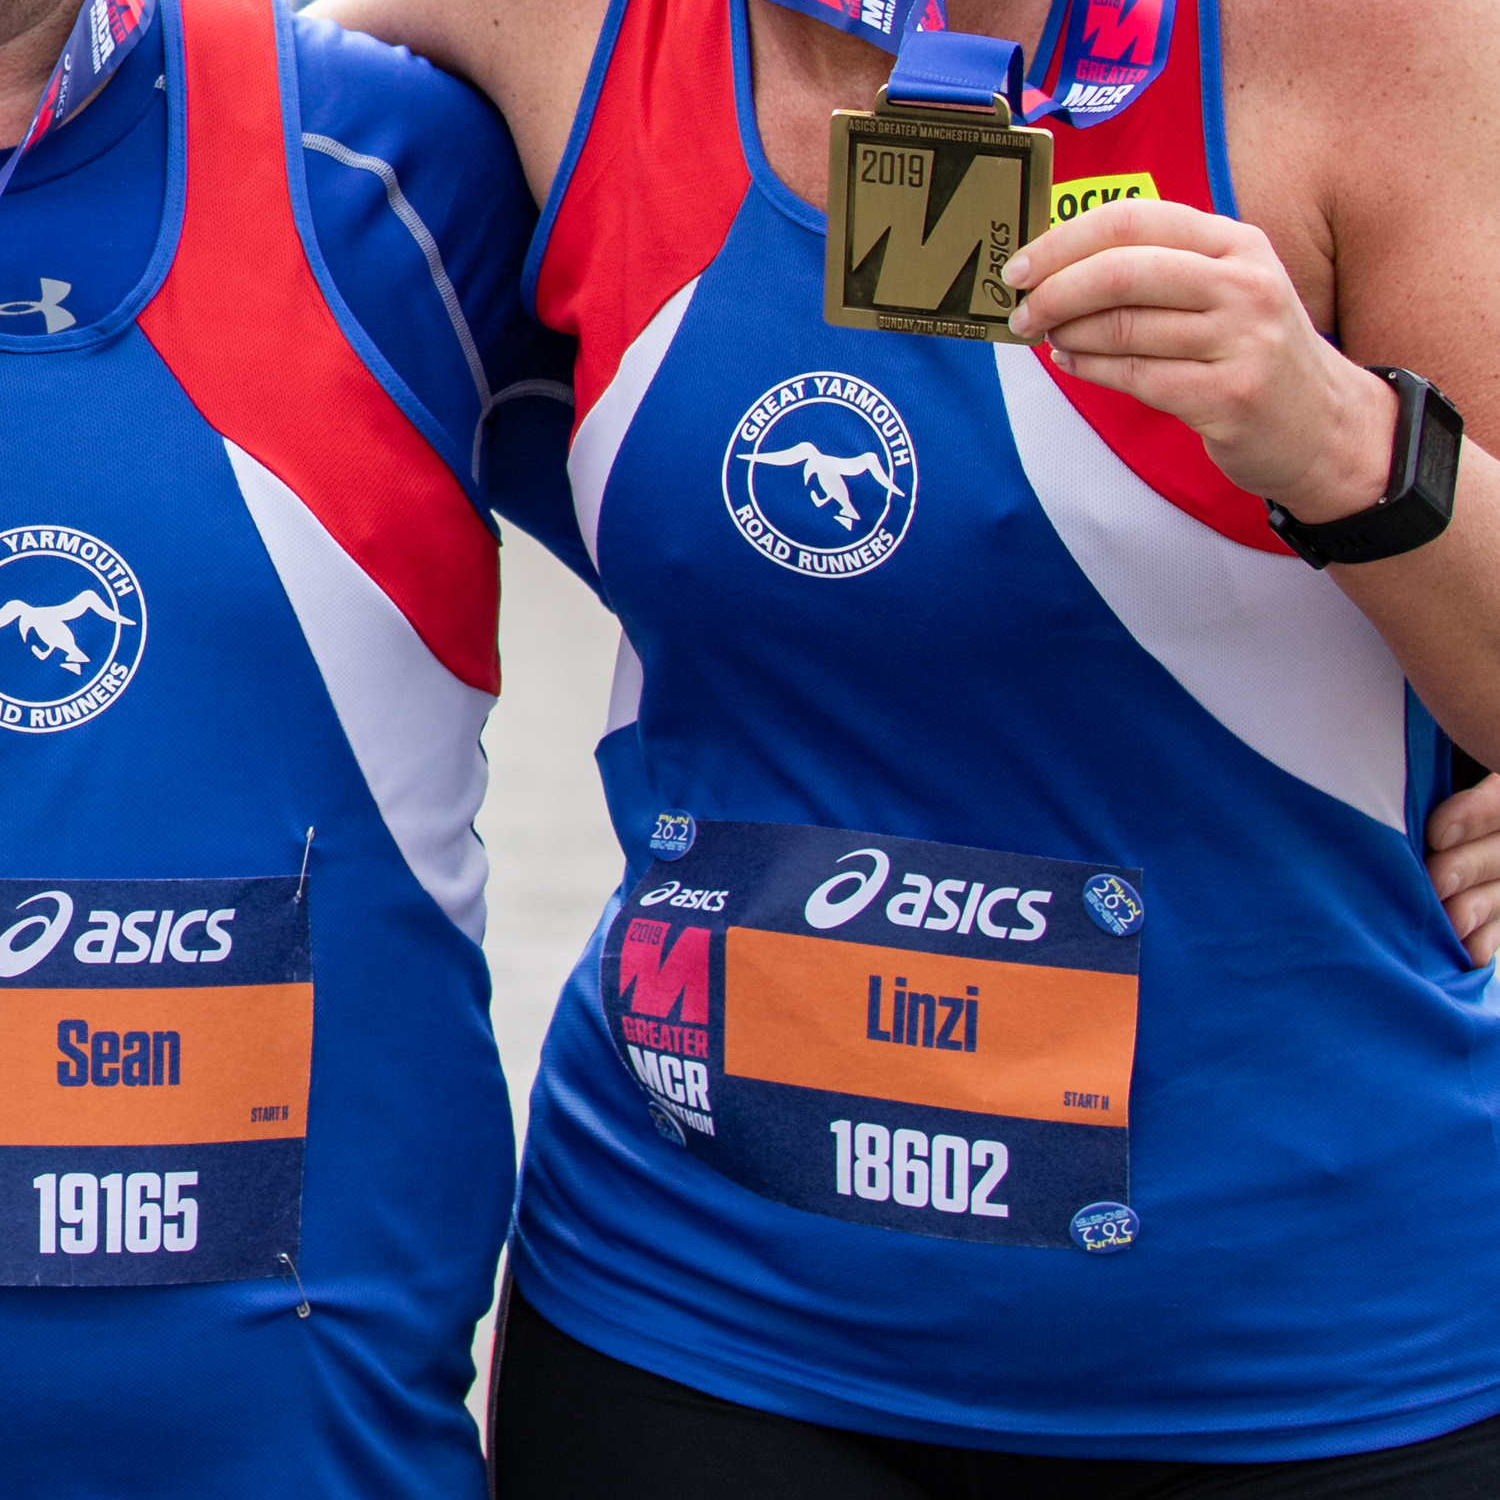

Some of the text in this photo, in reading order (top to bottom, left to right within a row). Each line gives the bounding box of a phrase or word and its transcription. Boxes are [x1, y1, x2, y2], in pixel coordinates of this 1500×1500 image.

[1075, 58, 1149, 84] GREATER
[1061, 82, 1135, 108] MCR
[849, 119, 1032, 148] ASICS GREATER MANCHESTER MARATHON
[860, 150, 925, 188] 2019
[878, 315, 986, 339] SUNDAY 7TH APRIL 2019
[740, 377, 911, 467] GREAT YARMOUTH
[735, 503, 895, 573] ROAD RUNNERS
[3, 531, 135, 598] YARMOUTH
[29, 661, 130, 728] RUNNERS
[651, 818, 688, 841] 26.2
[658, 814, 690, 825] RUN
[1092, 879, 1135, 929] 26.2
[1108, 877, 1142, 916] RUN
[628, 921, 662, 946] 2019
[866, 974, 980, 1054] Linzi
[56, 1018, 181, 1088] Sean
[621, 1015, 709, 1059] GREATER
[627, 1043, 712, 1112] MCR
[250, 1105, 290, 1123] START H
[1063, 1090, 1110, 1111] START H
[830, 1119, 1009, 1219] 18602
[33, 1171, 200, 1255] 19165
[1078, 1218, 1134, 1244] 26.2
[1086, 1235, 1132, 1251] RUN
